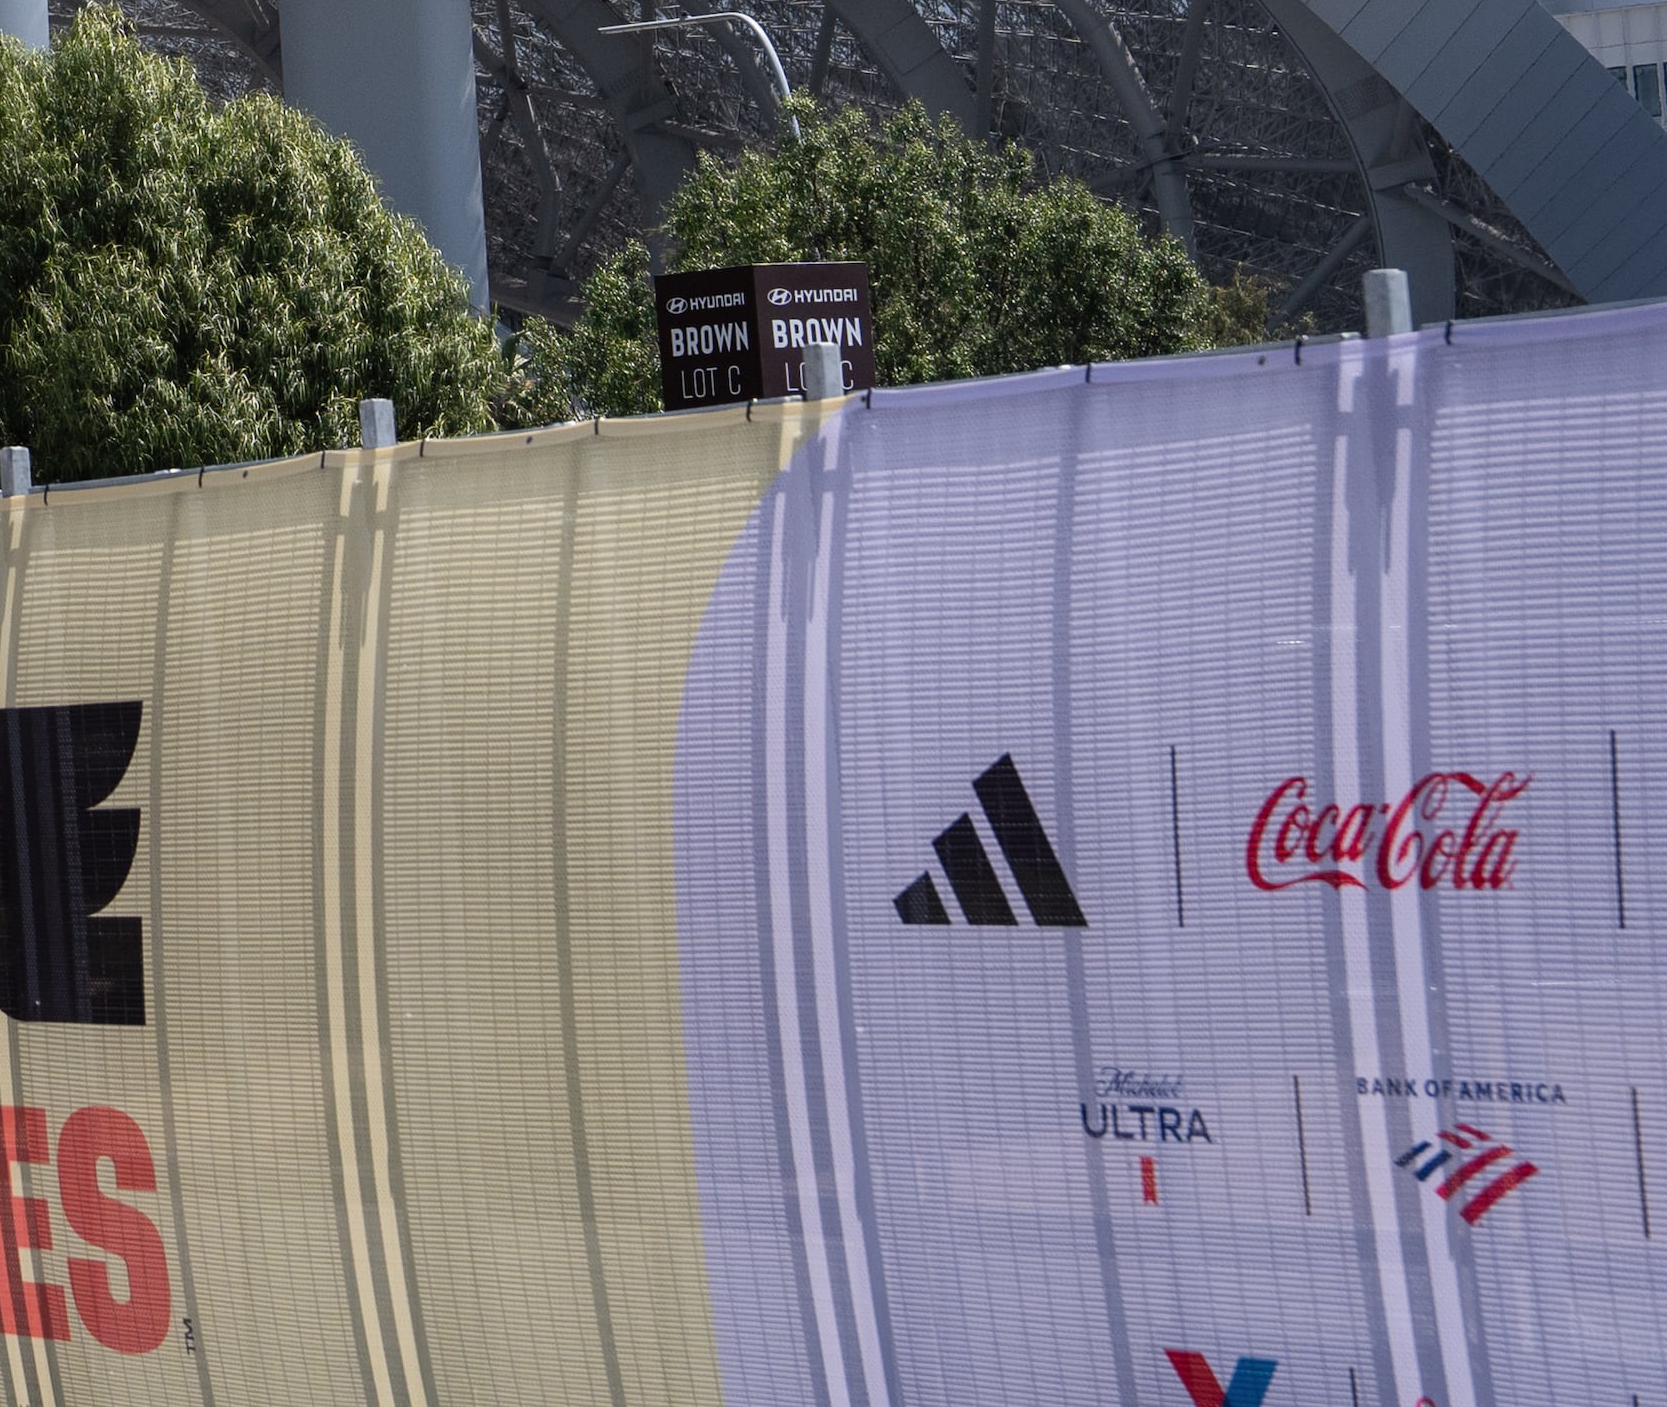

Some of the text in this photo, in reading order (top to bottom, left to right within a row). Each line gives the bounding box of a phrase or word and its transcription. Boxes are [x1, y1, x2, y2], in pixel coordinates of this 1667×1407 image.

[690, 292, 745, 310] HYUNDAI
[794, 288, 858, 303] HYUNDAI
[671, 321, 749, 357] BROWN
[772, 317, 863, 349] BROWN
[681, 365, 742, 399] LOT C
[1246, 772, 1534, 890] Coca-Cola
[1357, 1077, 1566, 1105] BANK OF AMERICA
[1081, 1103, 1212, 1143] ULTRA
